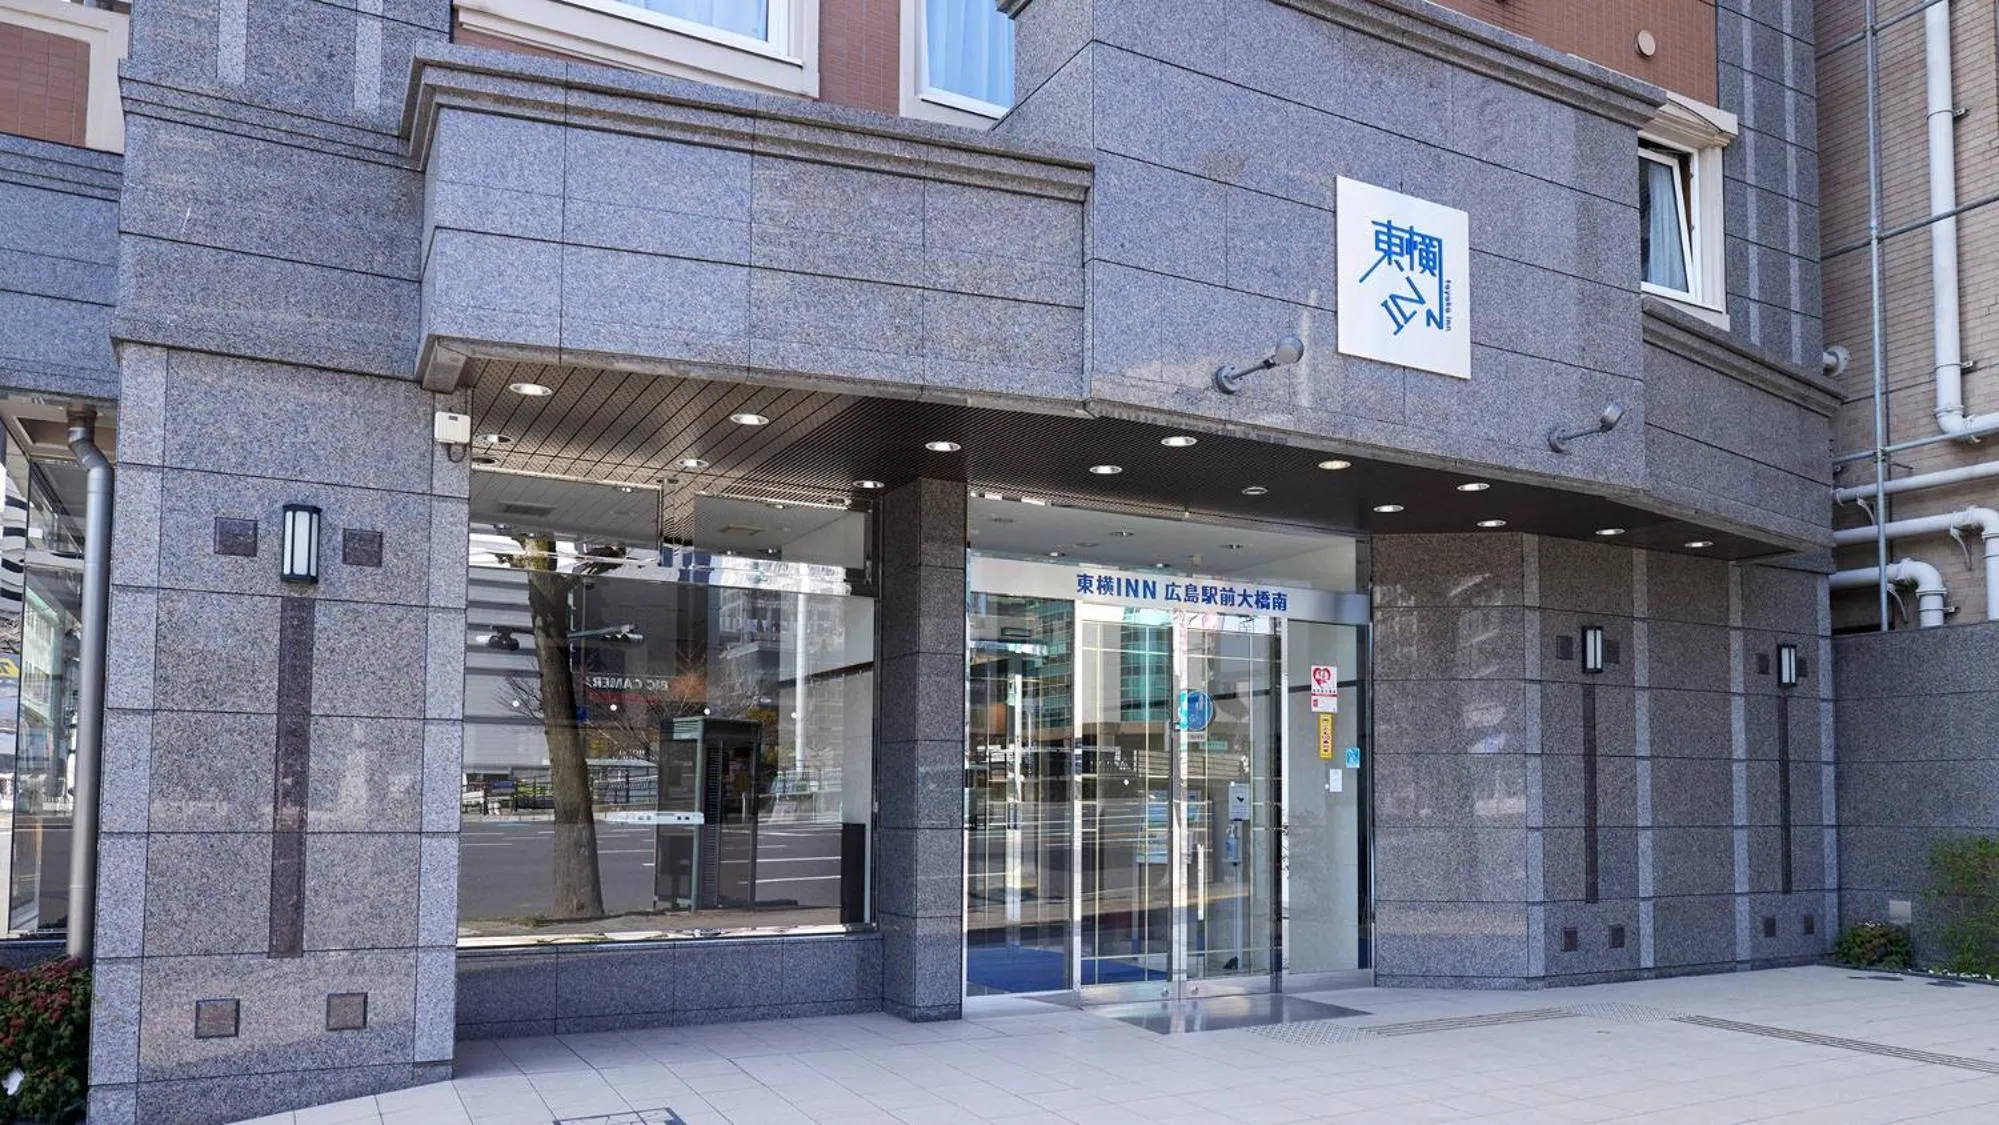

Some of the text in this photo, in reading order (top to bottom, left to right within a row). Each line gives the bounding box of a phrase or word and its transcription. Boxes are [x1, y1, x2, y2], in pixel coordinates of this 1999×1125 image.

[1076, 573, 1288, 611] 東横INN 広島駅前大橋南
